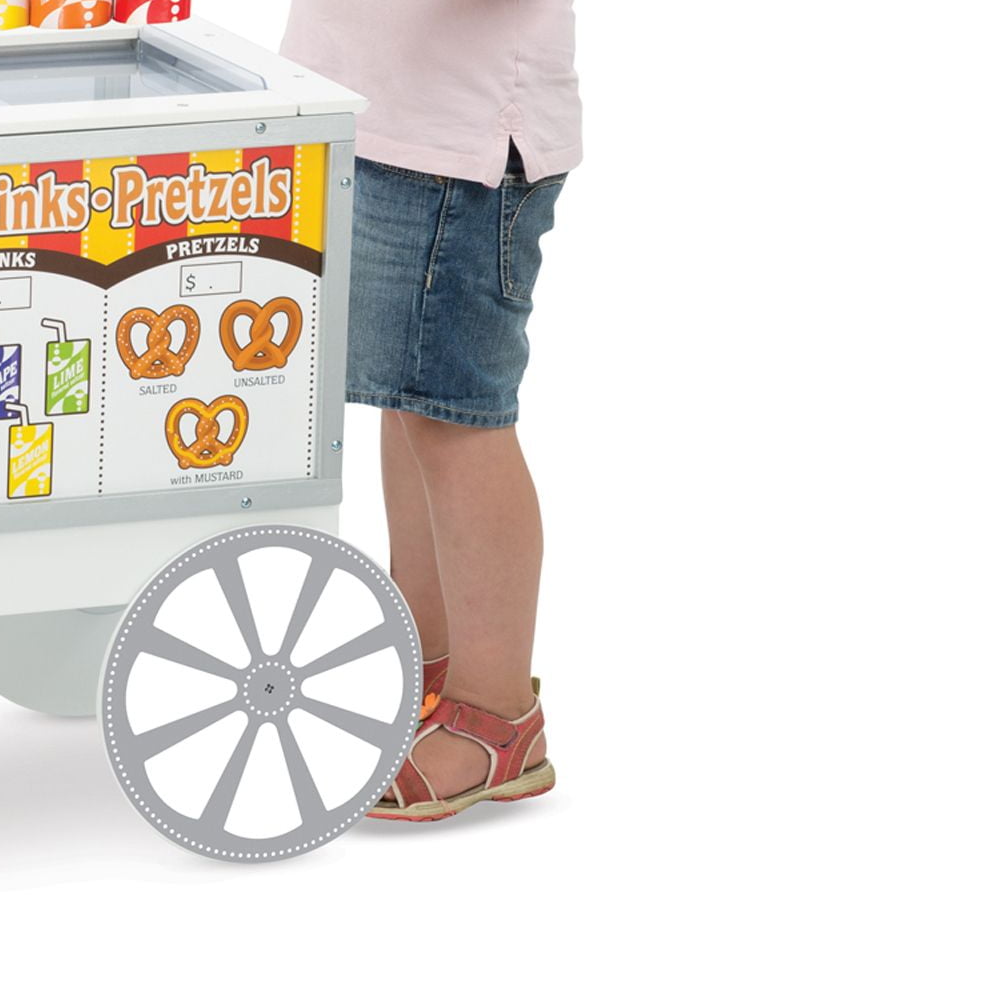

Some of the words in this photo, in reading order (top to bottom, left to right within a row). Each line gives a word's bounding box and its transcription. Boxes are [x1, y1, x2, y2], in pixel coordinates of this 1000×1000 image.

[110, 156, 293, 229] Pretzels
[166, 236, 261, 261] PRETZELS
[52, 358, 84, 391] LIME
[233, 374, 286, 388] UNSALTED
[139, 383, 178, 396] SALTED
[169, 474, 193, 485] with
[195, 470, 244, 483] MUSTARD
